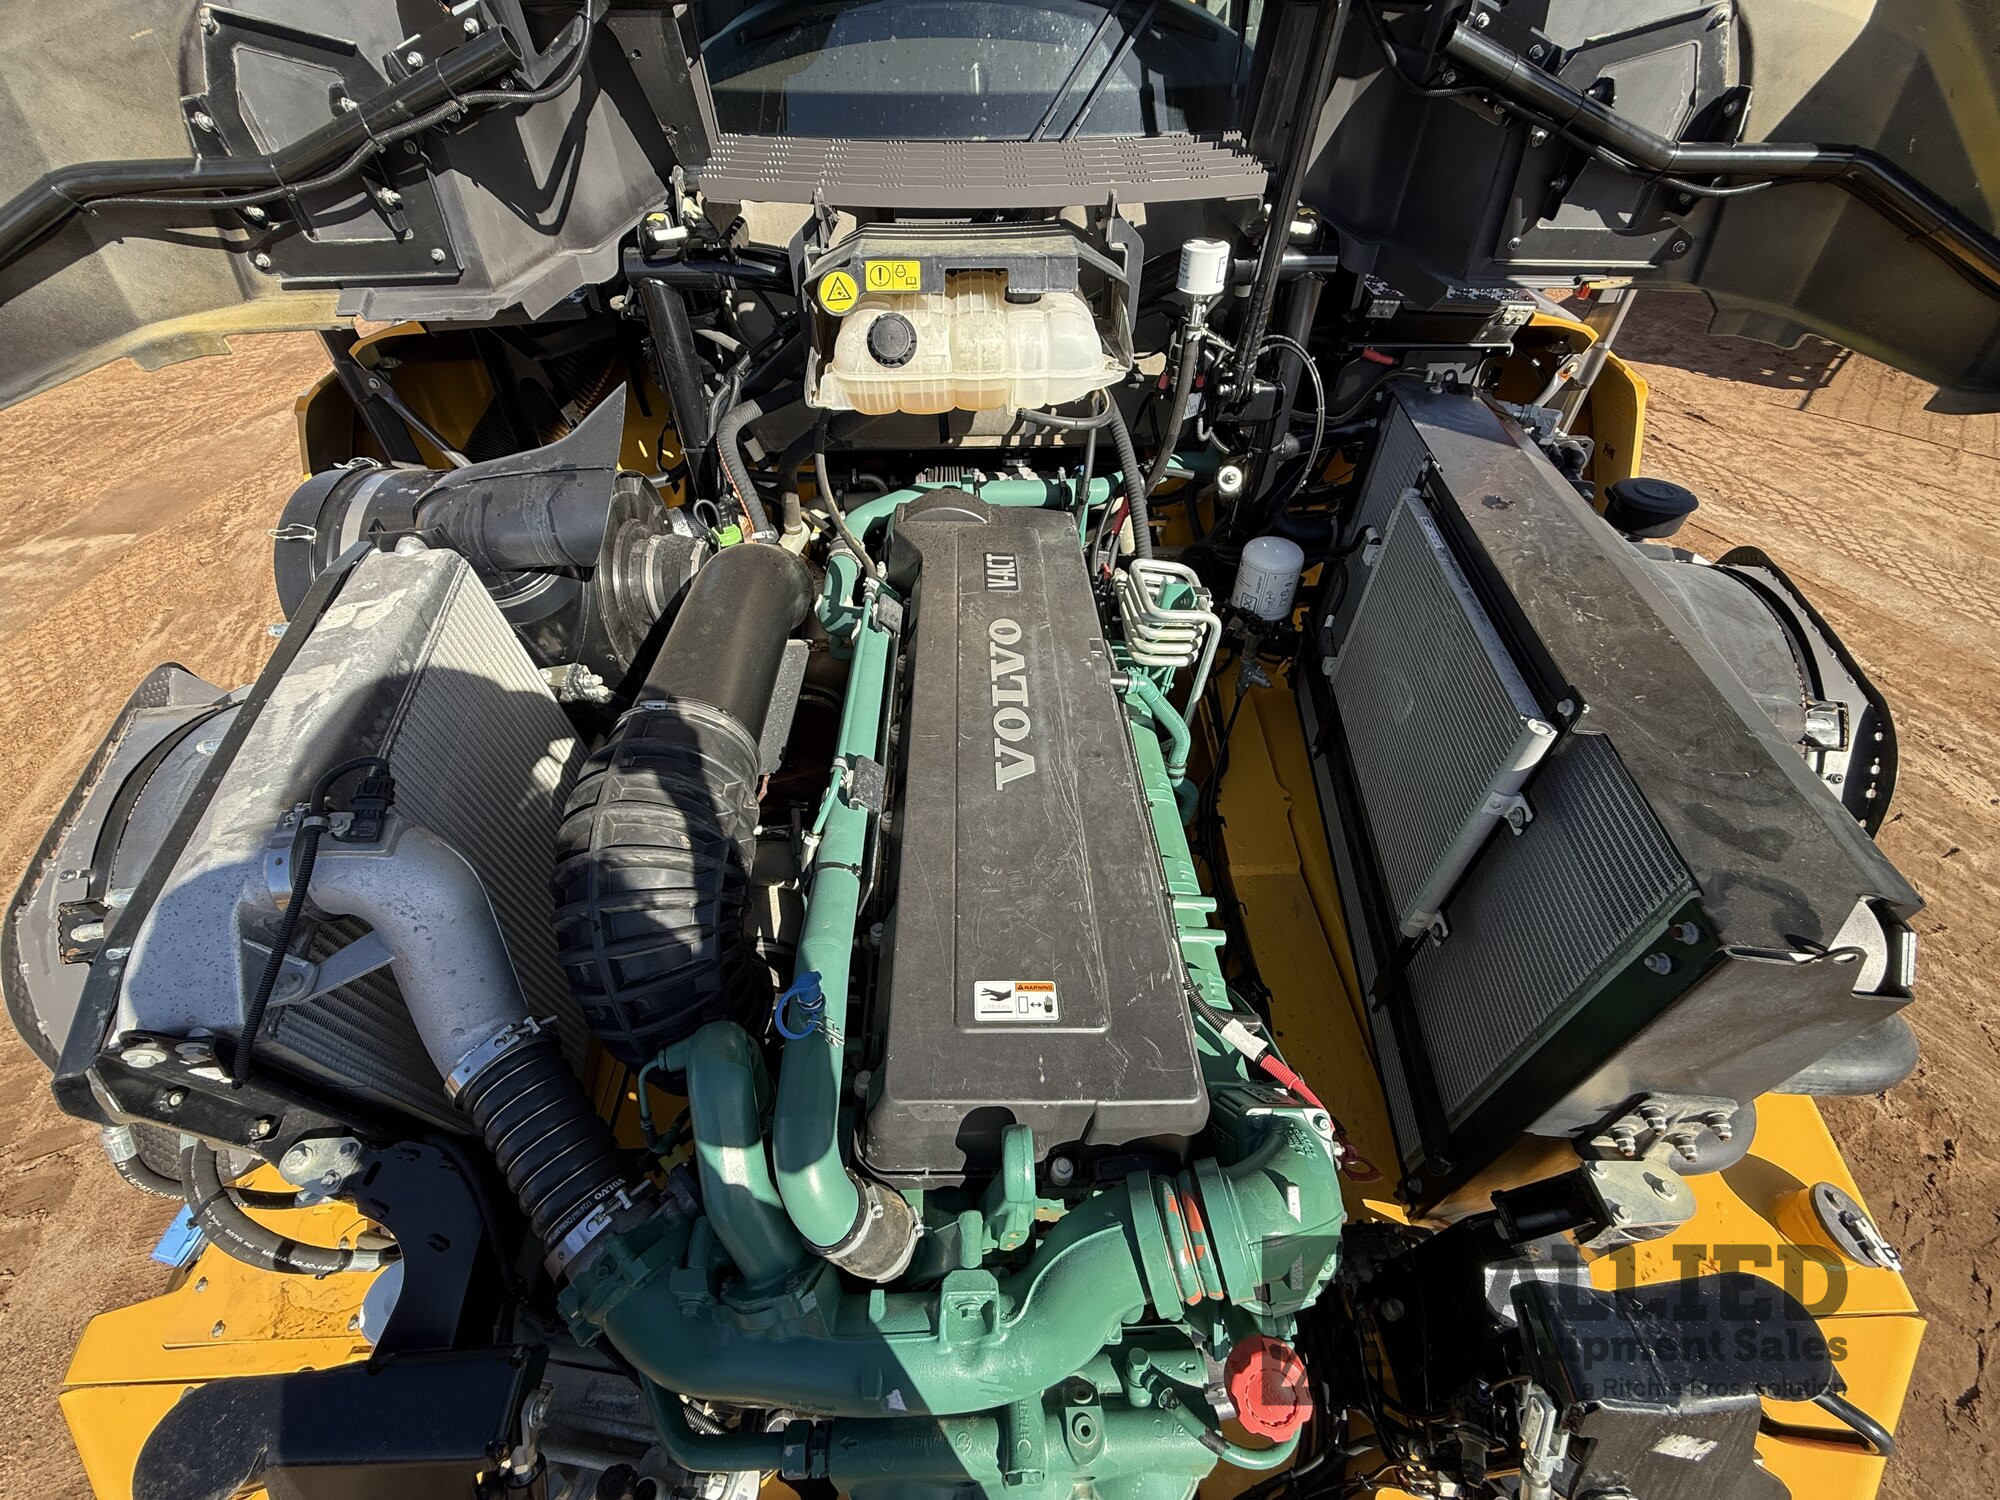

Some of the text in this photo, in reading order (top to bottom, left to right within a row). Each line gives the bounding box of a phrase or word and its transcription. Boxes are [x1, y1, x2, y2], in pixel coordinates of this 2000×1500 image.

[986, 553, 1017, 588] V-ACT
[988, 618, 1036, 791] VOLVO
[594, 1178, 626, 1200] VOLVO
